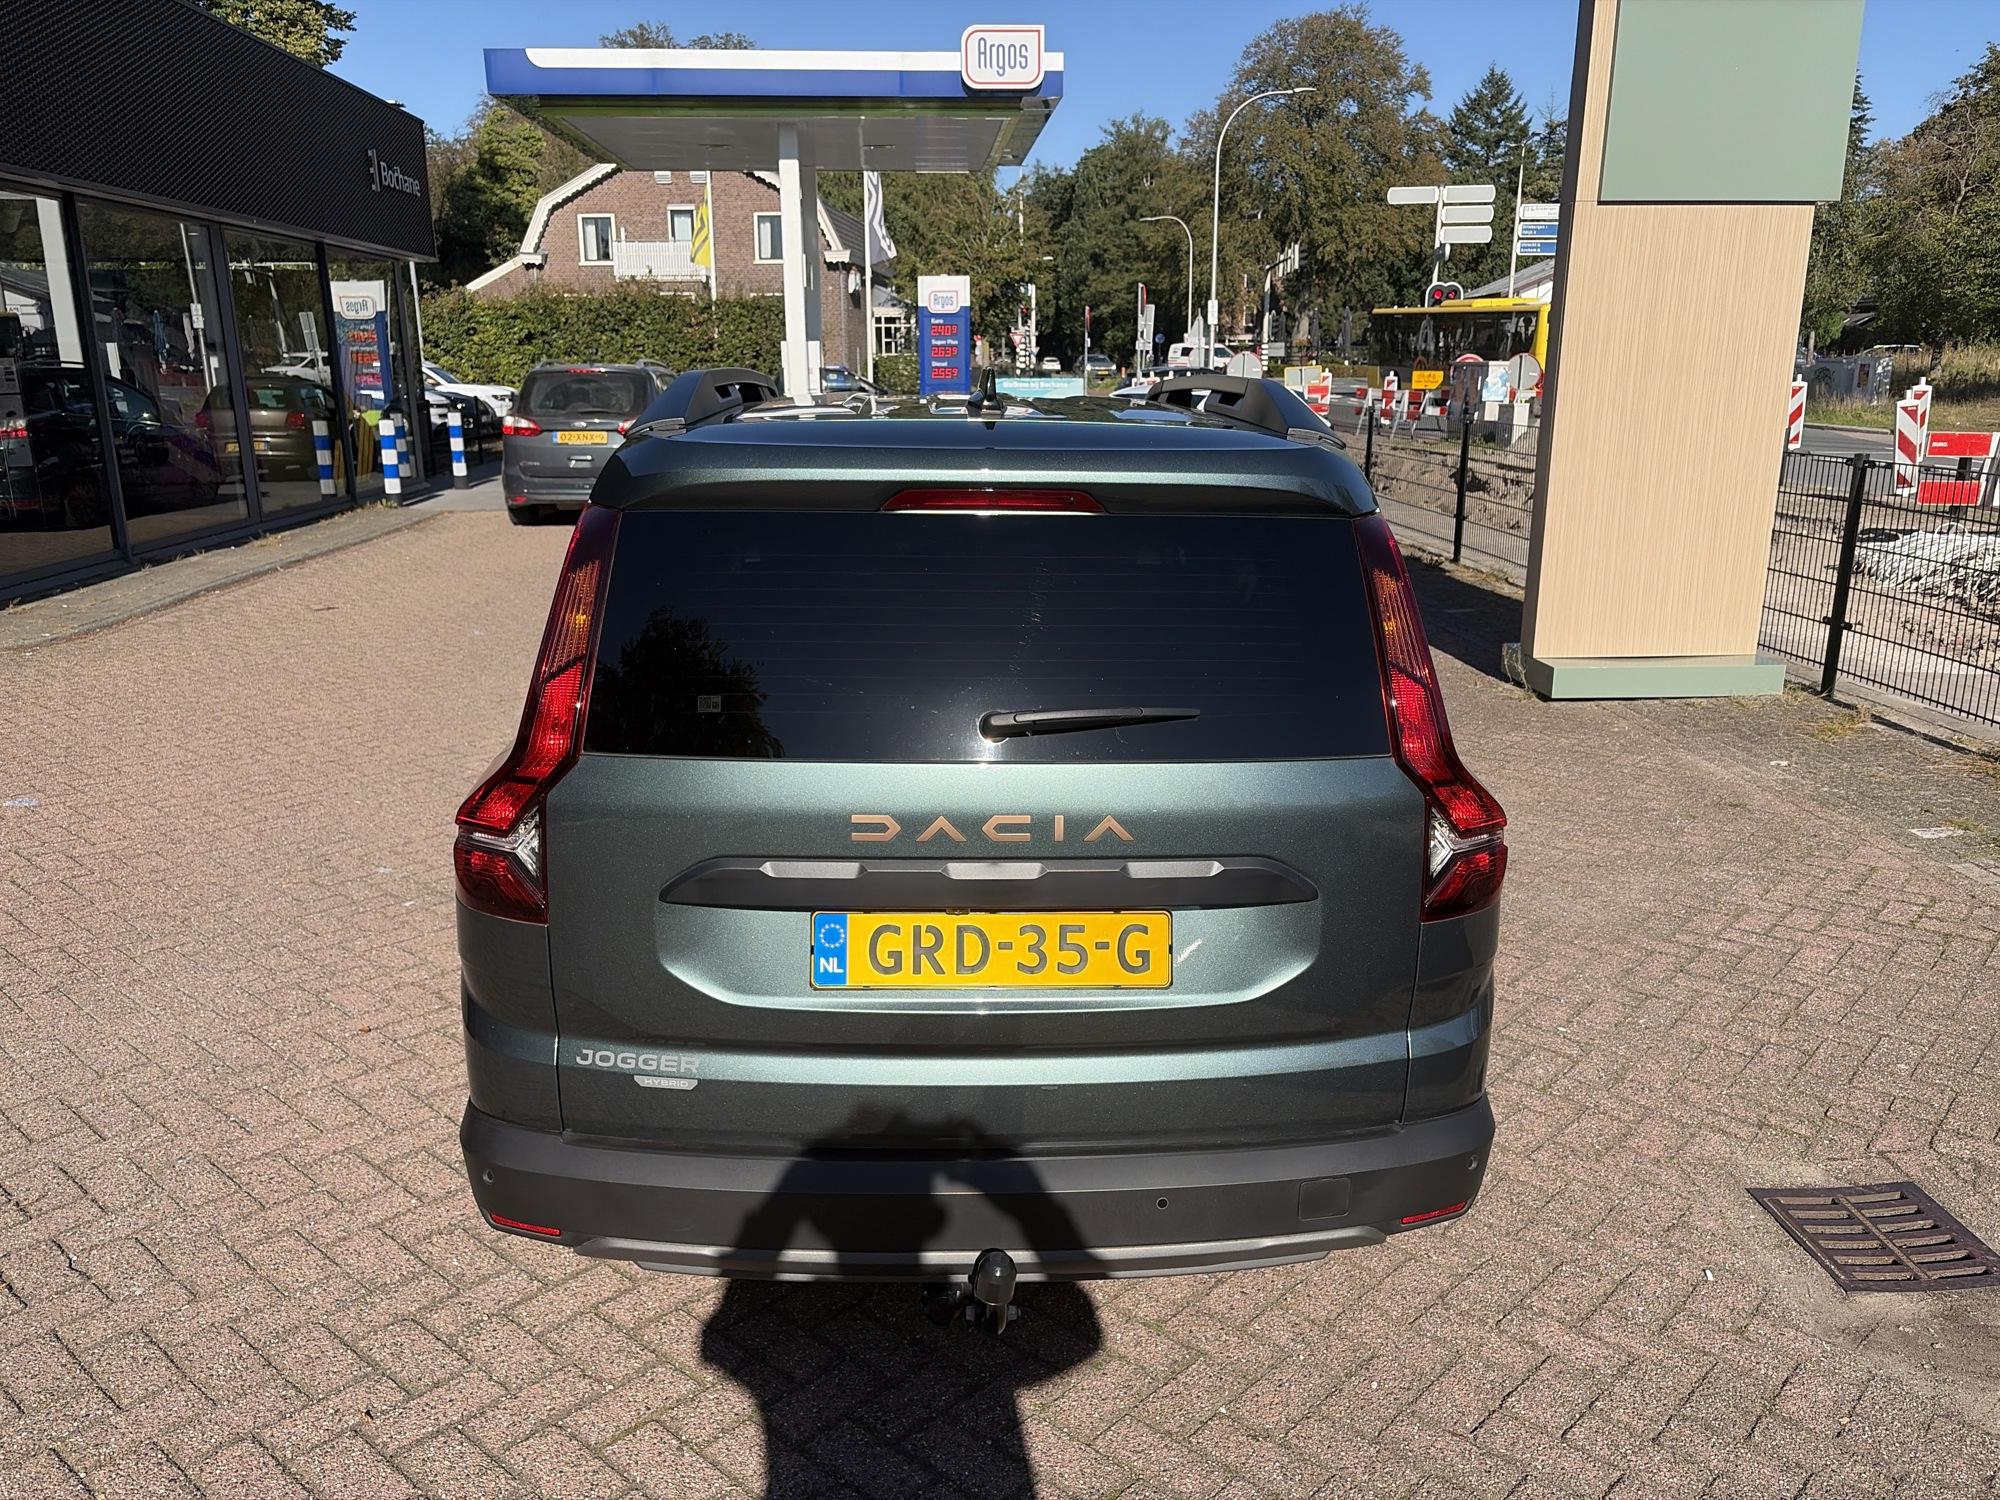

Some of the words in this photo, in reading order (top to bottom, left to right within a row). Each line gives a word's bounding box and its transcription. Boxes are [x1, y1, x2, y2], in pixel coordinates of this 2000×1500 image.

[977, 36, 1029, 78] Argos
[380, 161, 420, 197] Bochane
[933, 293, 954, 309] Argos
[560, 433, 605, 441] 02-XNX-9
[851, 814, 1134, 843] DACIA
[868, 923, 1151, 975] GRD-35-G
[819, 956, 844, 973] NL
[575, 1049, 699, 1073] JOGGER
[644, 1078, 689, 1087] HYBRID
